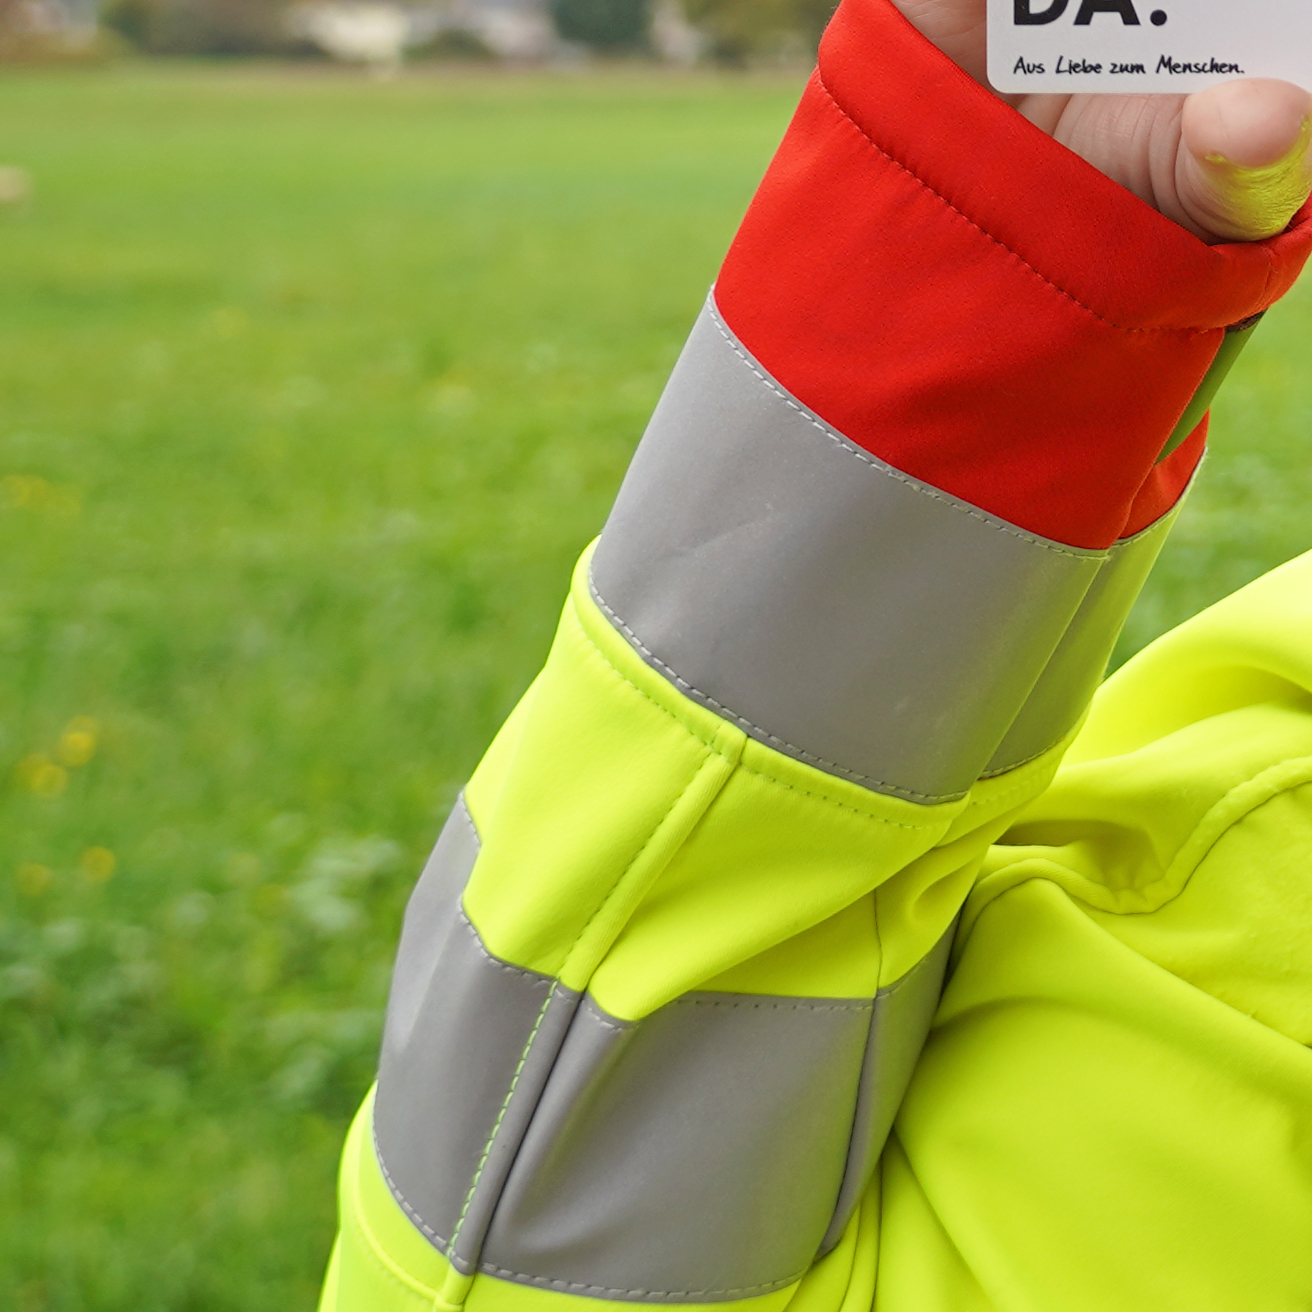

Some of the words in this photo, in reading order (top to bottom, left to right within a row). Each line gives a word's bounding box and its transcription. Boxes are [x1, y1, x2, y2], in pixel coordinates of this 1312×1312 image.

[1012, 55, 1046, 76] Aus
[1054, 55, 1103, 75] Liebe
[1108, 62, 1147, 76] zum
[1155, 54, 1246, 76] Menschen.
